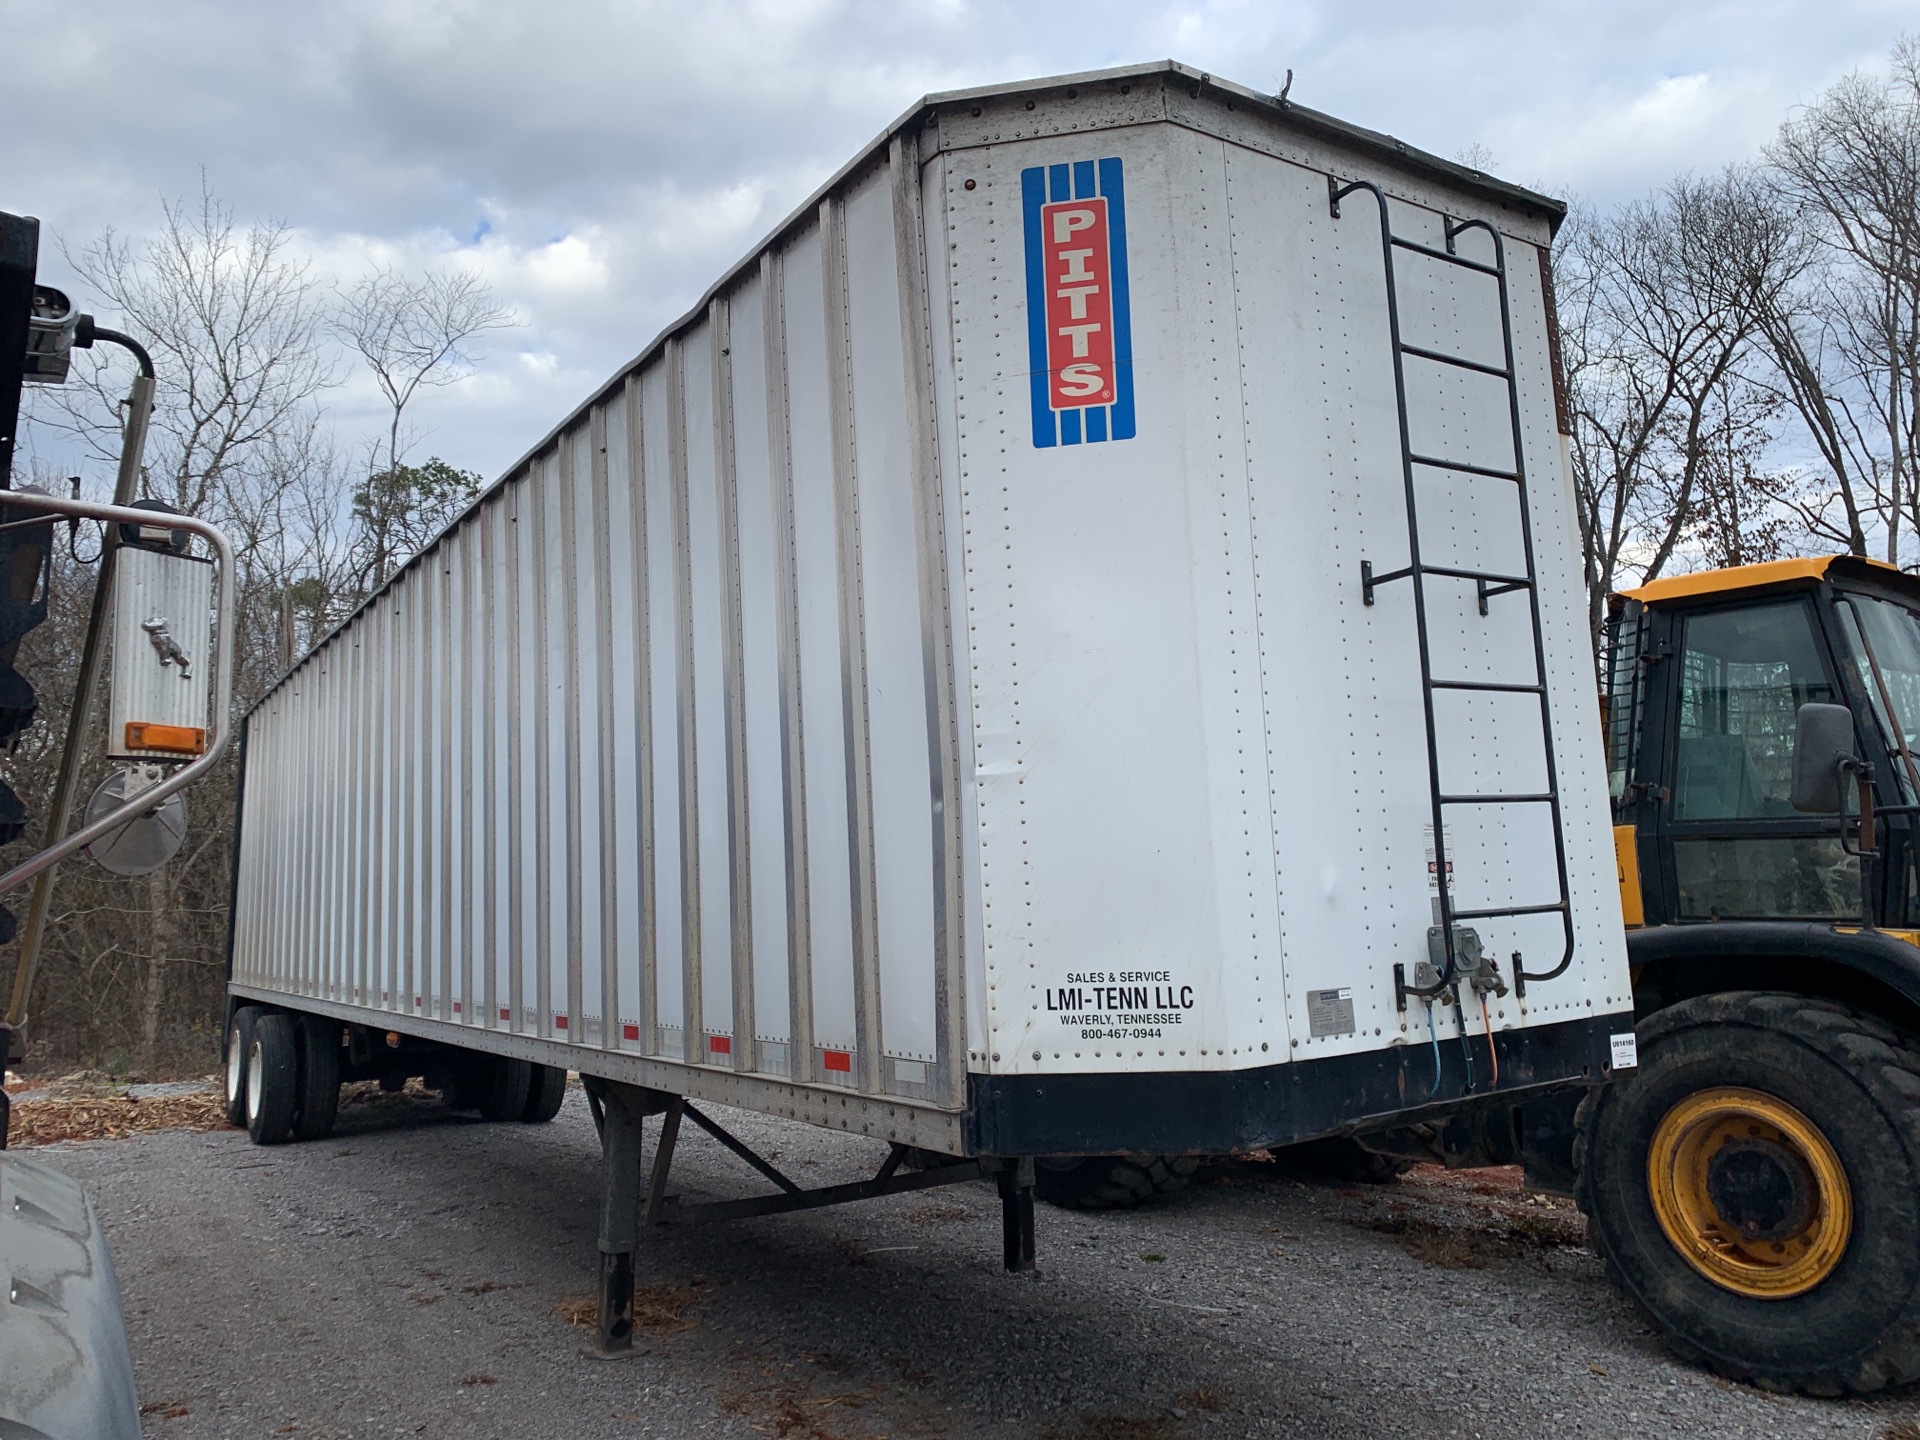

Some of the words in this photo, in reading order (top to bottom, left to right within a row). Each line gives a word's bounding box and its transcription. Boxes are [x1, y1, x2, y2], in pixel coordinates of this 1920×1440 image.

[1053, 209, 1104, 397] PITTS
[1067, 972, 1105, 983] SALES
[1108, 973, 1116, 982] &
[1119, 971, 1171, 982] SERVICE
[1046, 986, 1148, 1011] LMI-TENN
[1155, 985, 1194, 1010] LLC
[1060, 1014, 1114, 1026] WAVERLY,
[1117, 1013, 1182, 1025] TENNESSEE
[1081, 1028, 1162, 1039] 800-467-0944
